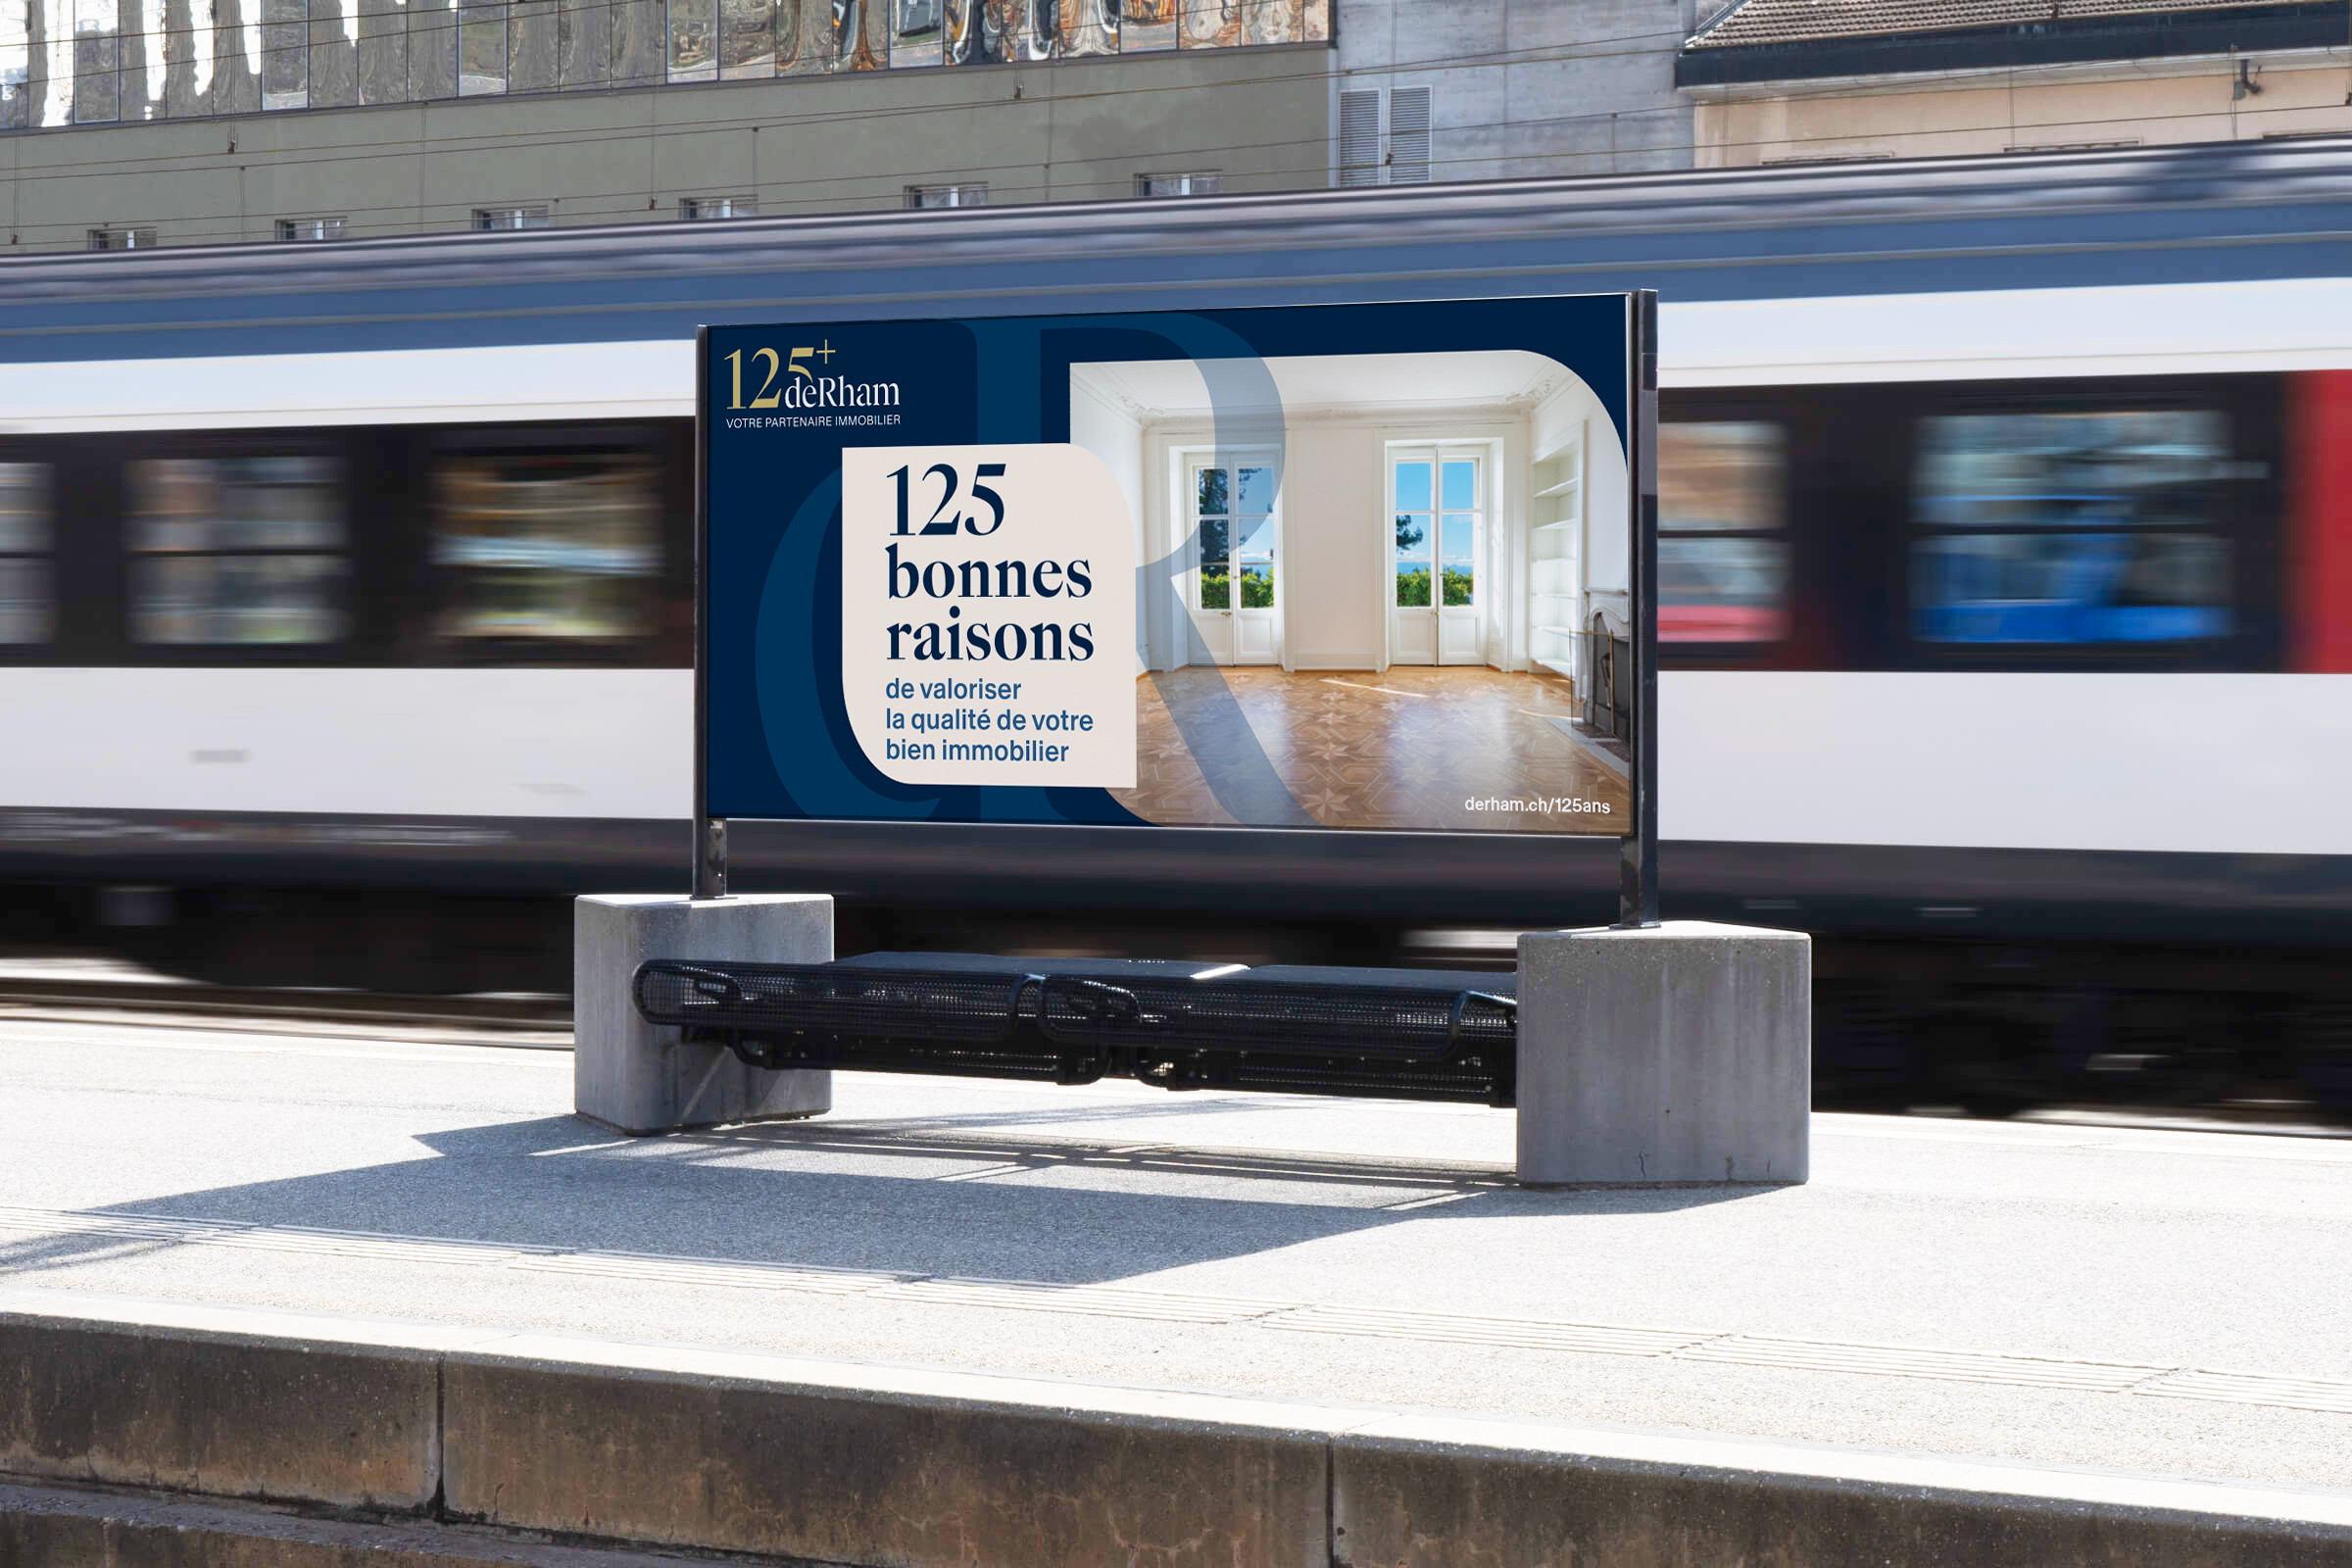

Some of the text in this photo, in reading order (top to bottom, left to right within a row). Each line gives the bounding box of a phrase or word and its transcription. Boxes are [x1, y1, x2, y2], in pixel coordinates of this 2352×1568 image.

[784, 374, 901, 409] deRham
[725, 414, 902, 429] VOTRE PARTENAIRE IMMOBILIER
[886, 463, 1007, 536] 125
[884, 541, 1093, 600] bonnes
[886, 605, 1095, 662] raisons
[885, 677, 1022, 700] de valoriser
[886, 708, 1095, 734] la qualité de votre
[886, 738, 1070, 762] bien immobilier
[1464, 796, 1612, 814] derham.ch/125ans
